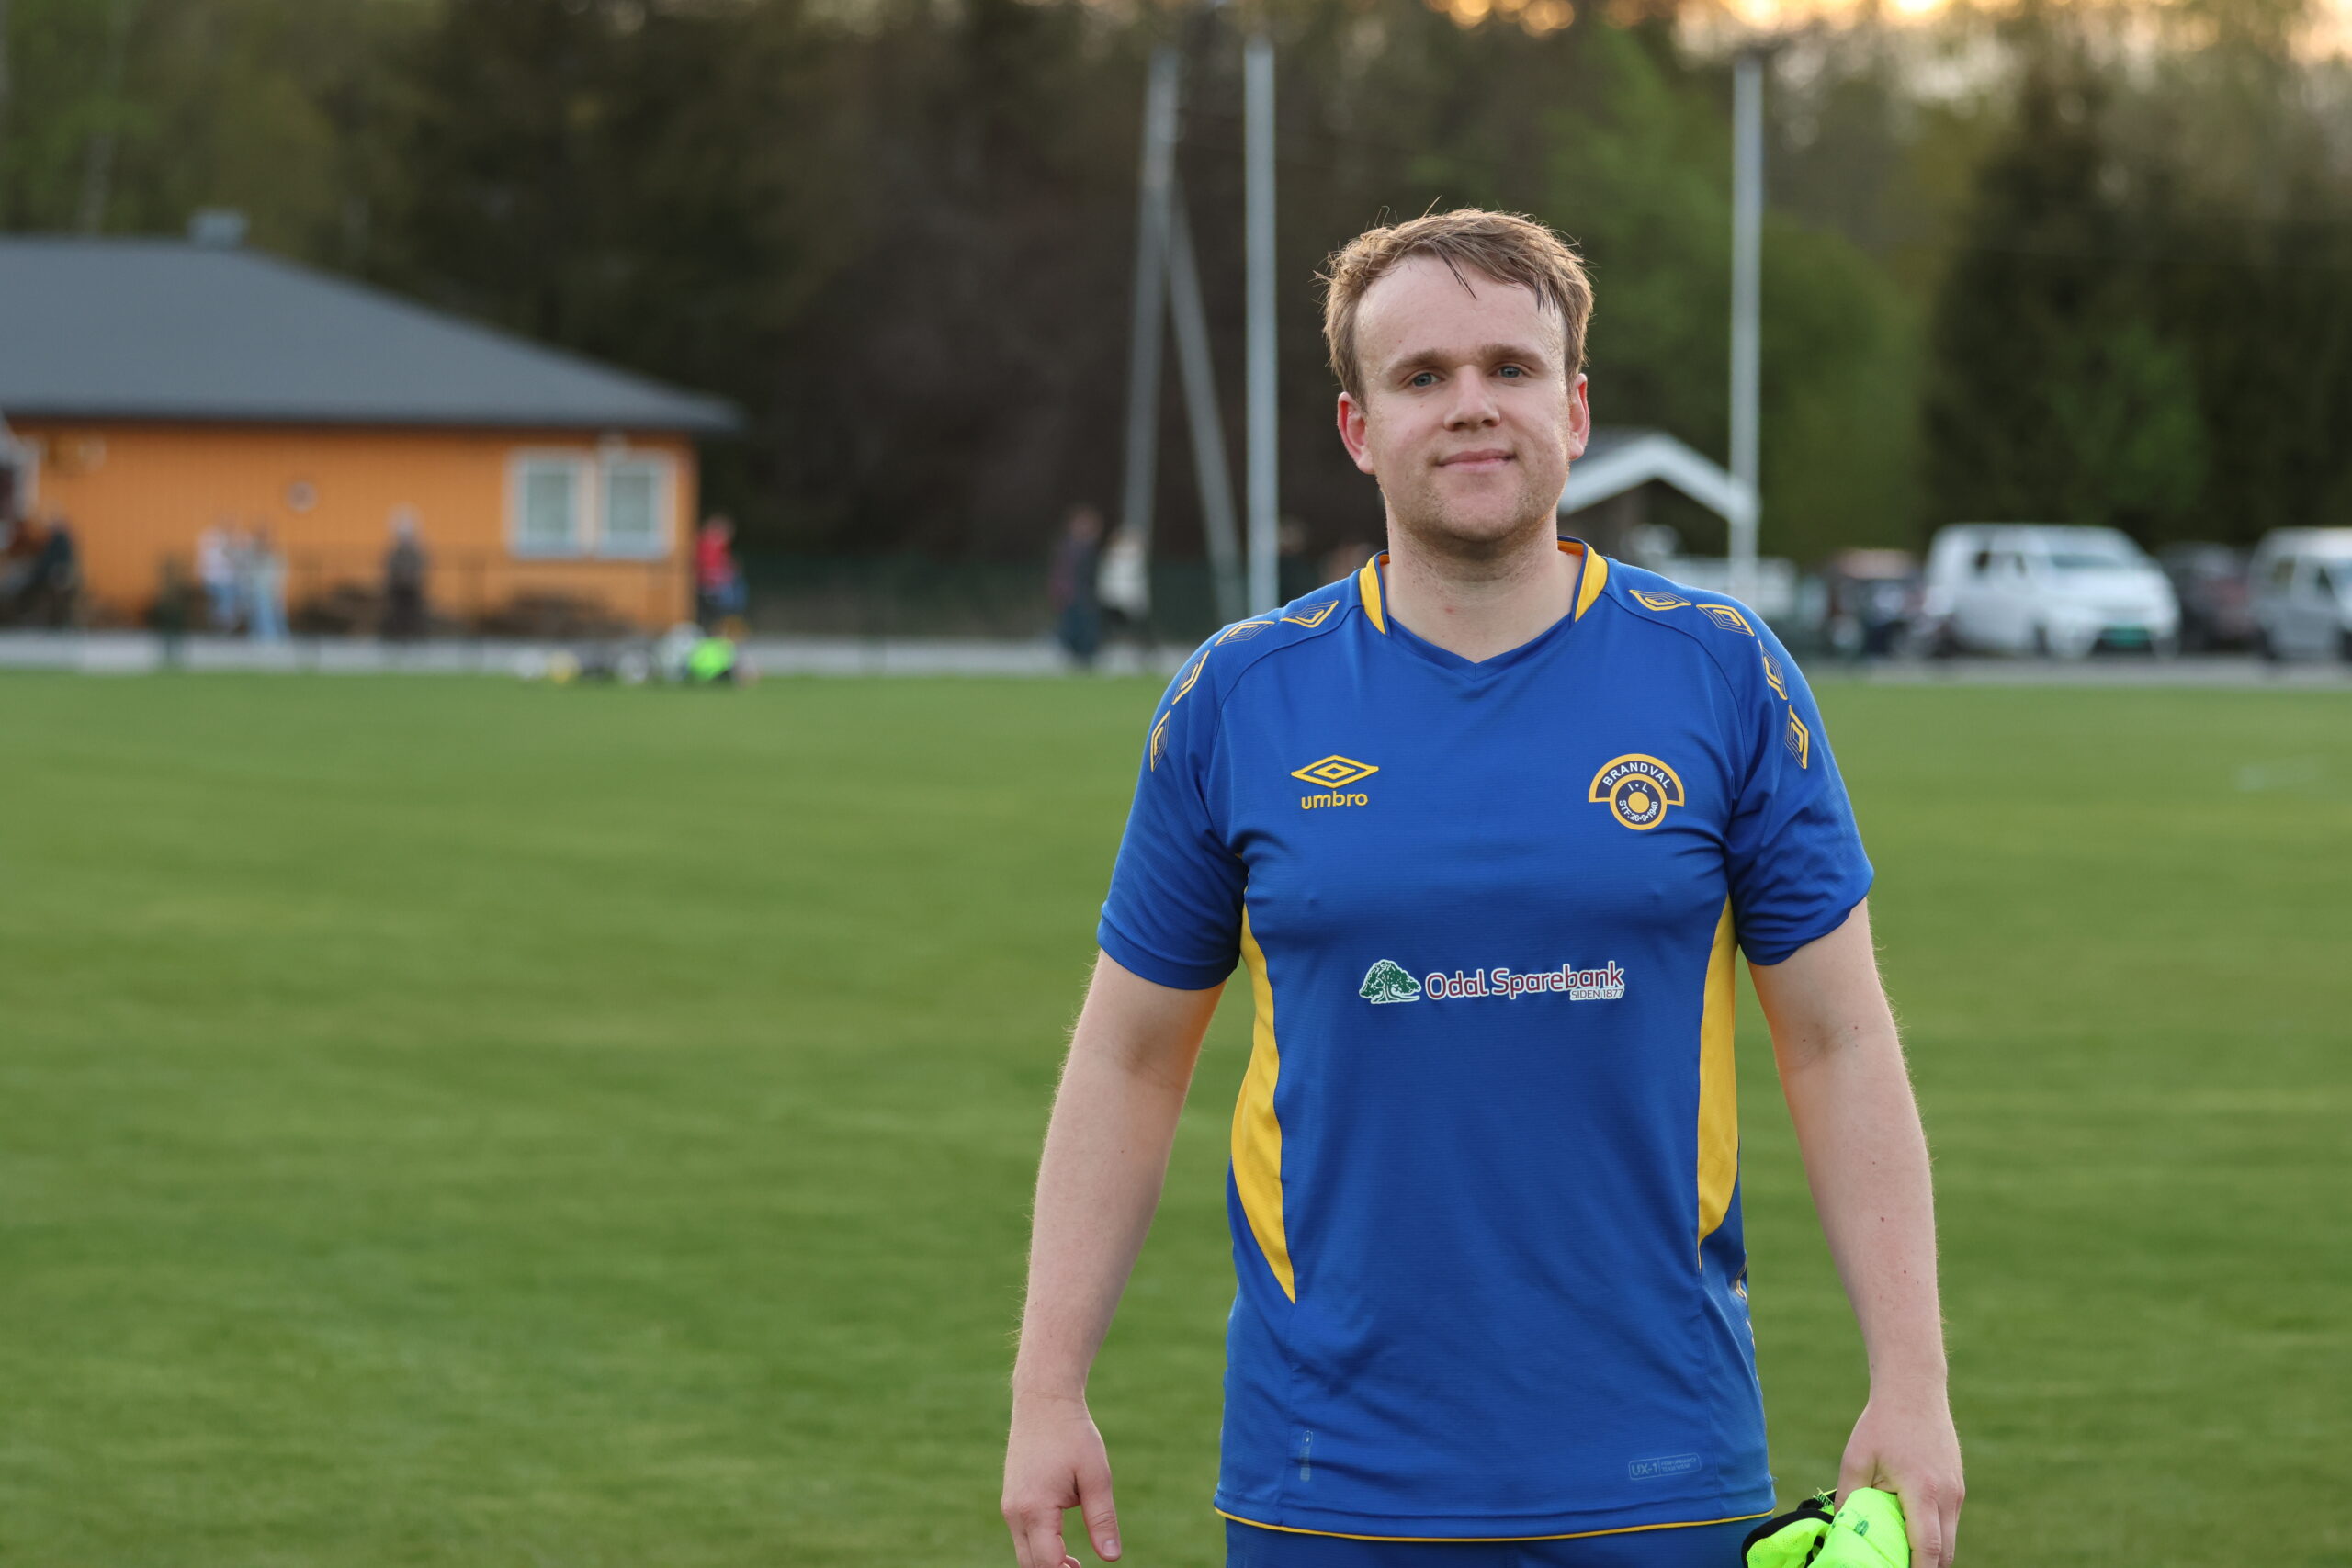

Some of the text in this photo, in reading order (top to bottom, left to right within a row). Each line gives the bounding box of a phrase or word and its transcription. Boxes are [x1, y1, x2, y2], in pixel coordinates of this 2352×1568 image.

[1602, 761, 1671, 788] BRANDVAL
[1301, 791, 1368, 809] umbro
[1426, 961, 1623, 998] Odal Sparebank
[1571, 988, 1623, 999] SIDEN 1877
[1631, 1461, 1658, 1476] UX-1
